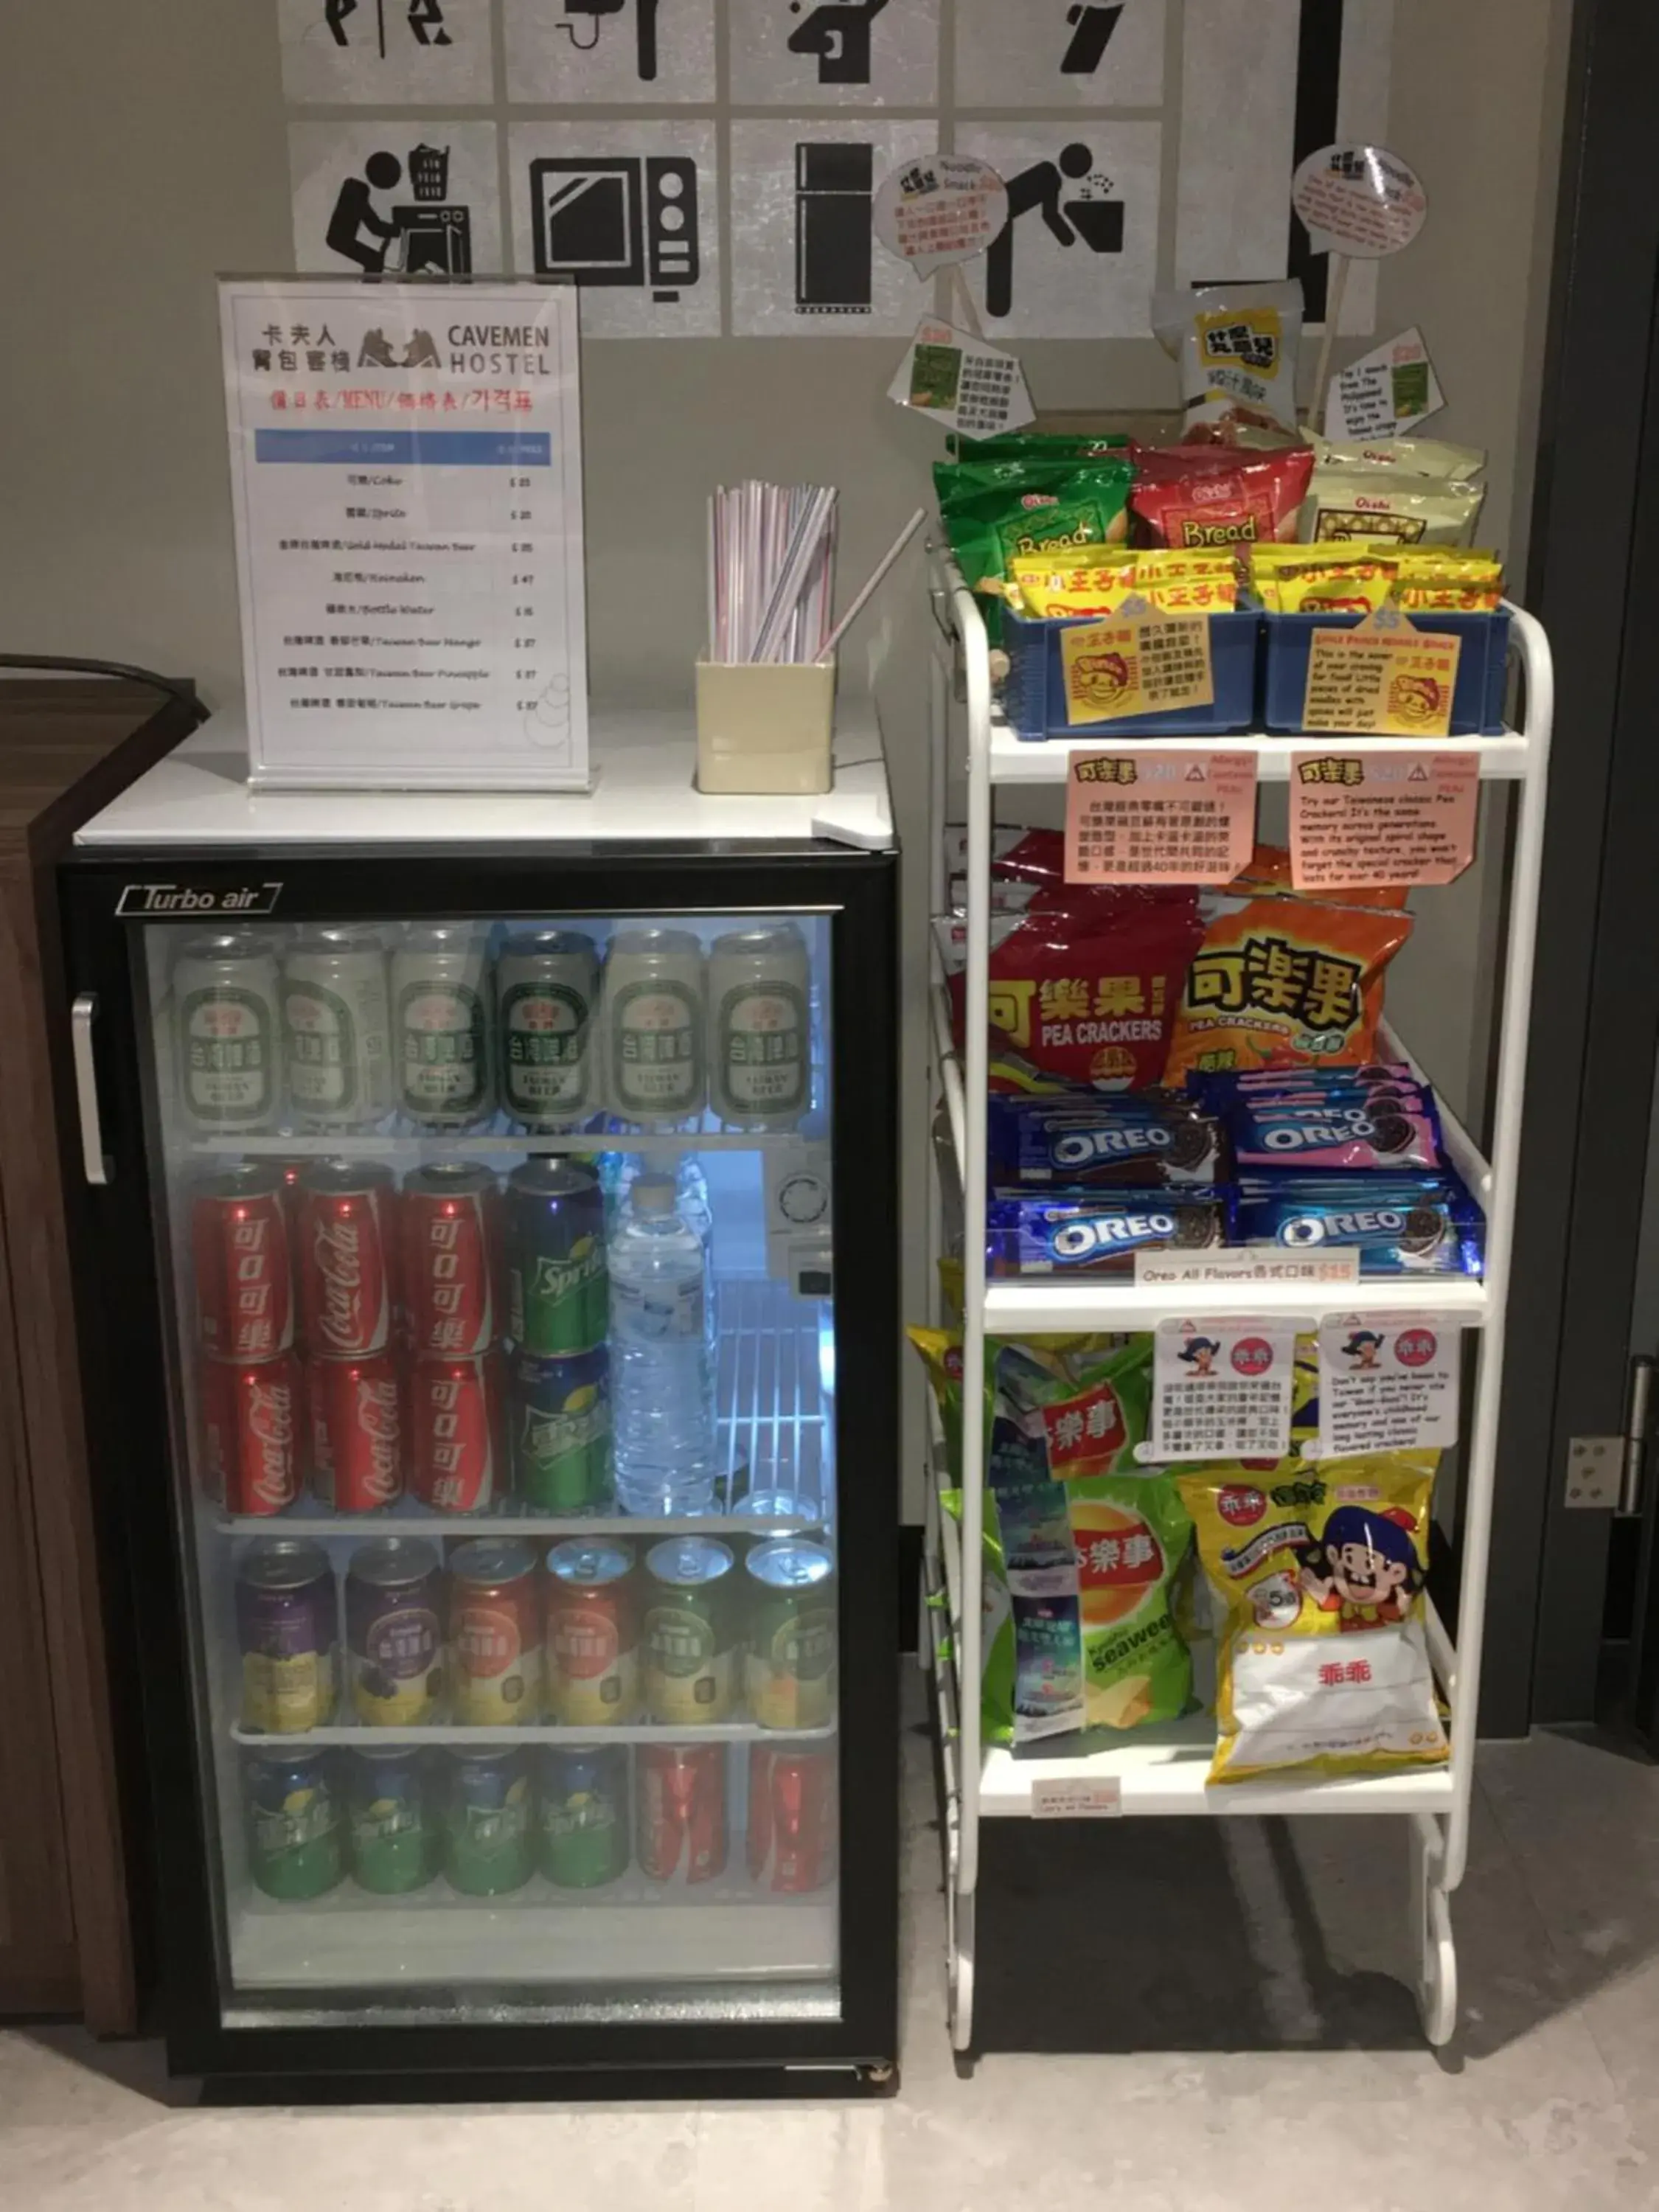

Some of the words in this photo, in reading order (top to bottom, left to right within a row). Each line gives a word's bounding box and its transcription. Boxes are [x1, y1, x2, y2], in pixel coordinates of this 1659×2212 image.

[262, 324, 335, 345] 卡夫人
[448, 325, 549, 347] CAVEMEN
[451, 352, 552, 375] HOSTEL
[1018, 521, 1088, 555] Bread
[1183, 521, 1256, 548] Bread
[1300, 796, 1318, 807] Try
[1343, 795, 1395, 805] Taiwanese
[1436, 794, 1455, 804] Pea
[1350, 807, 1369, 818] It's
[1373, 807, 1391, 816] the
[1300, 822, 1338, 833] memory
[1341, 821, 1374, 831] across
[1345, 833, 1382, 846] original
[1416, 832, 1447, 843] shape
[1300, 848, 1318, 858] and
[1322, 846, 1361, 858] crunchy
[1409, 846, 1427, 855] you
[1301, 860, 1332, 872] forget
[1335, 859, 1352, 869] the
[1356, 858, 1389, 870] special
[1393, 857, 1432, 867] cracker
[1329, 872, 1345, 882] for
[144, 884, 215, 909] Turbo
[221, 887, 260, 908] air
[989, 976, 1144, 1048] 可樂果
[1041, 1024, 1074, 1047] PEA
[1076, 1019, 1163, 1045] CRACKERS
[1189, 1017, 1214, 1032] PEA
[1218, 1017, 1290, 1035] CRACKERS
[1054, 1127, 1172, 1164] OREO
[1265, 1121, 1375, 1150] OREO
[1054, 1214, 1175, 1255] OREO
[1283, 1211, 1402, 1247] OREO
[234, 1218, 271, 1351] 可口可樂
[431, 1218, 467, 1348] 可口可樂
[1144, 1270, 1175, 1282] Oreo
[1181, 1268, 1200, 1280] All
[1055, 1400, 1116, 1451] 樂事
[431, 1380, 467, 1505] 可口可樂
[1090, 1534, 1155, 1573] 樂事
[1318, 1659, 1372, 1686] 乖乖
